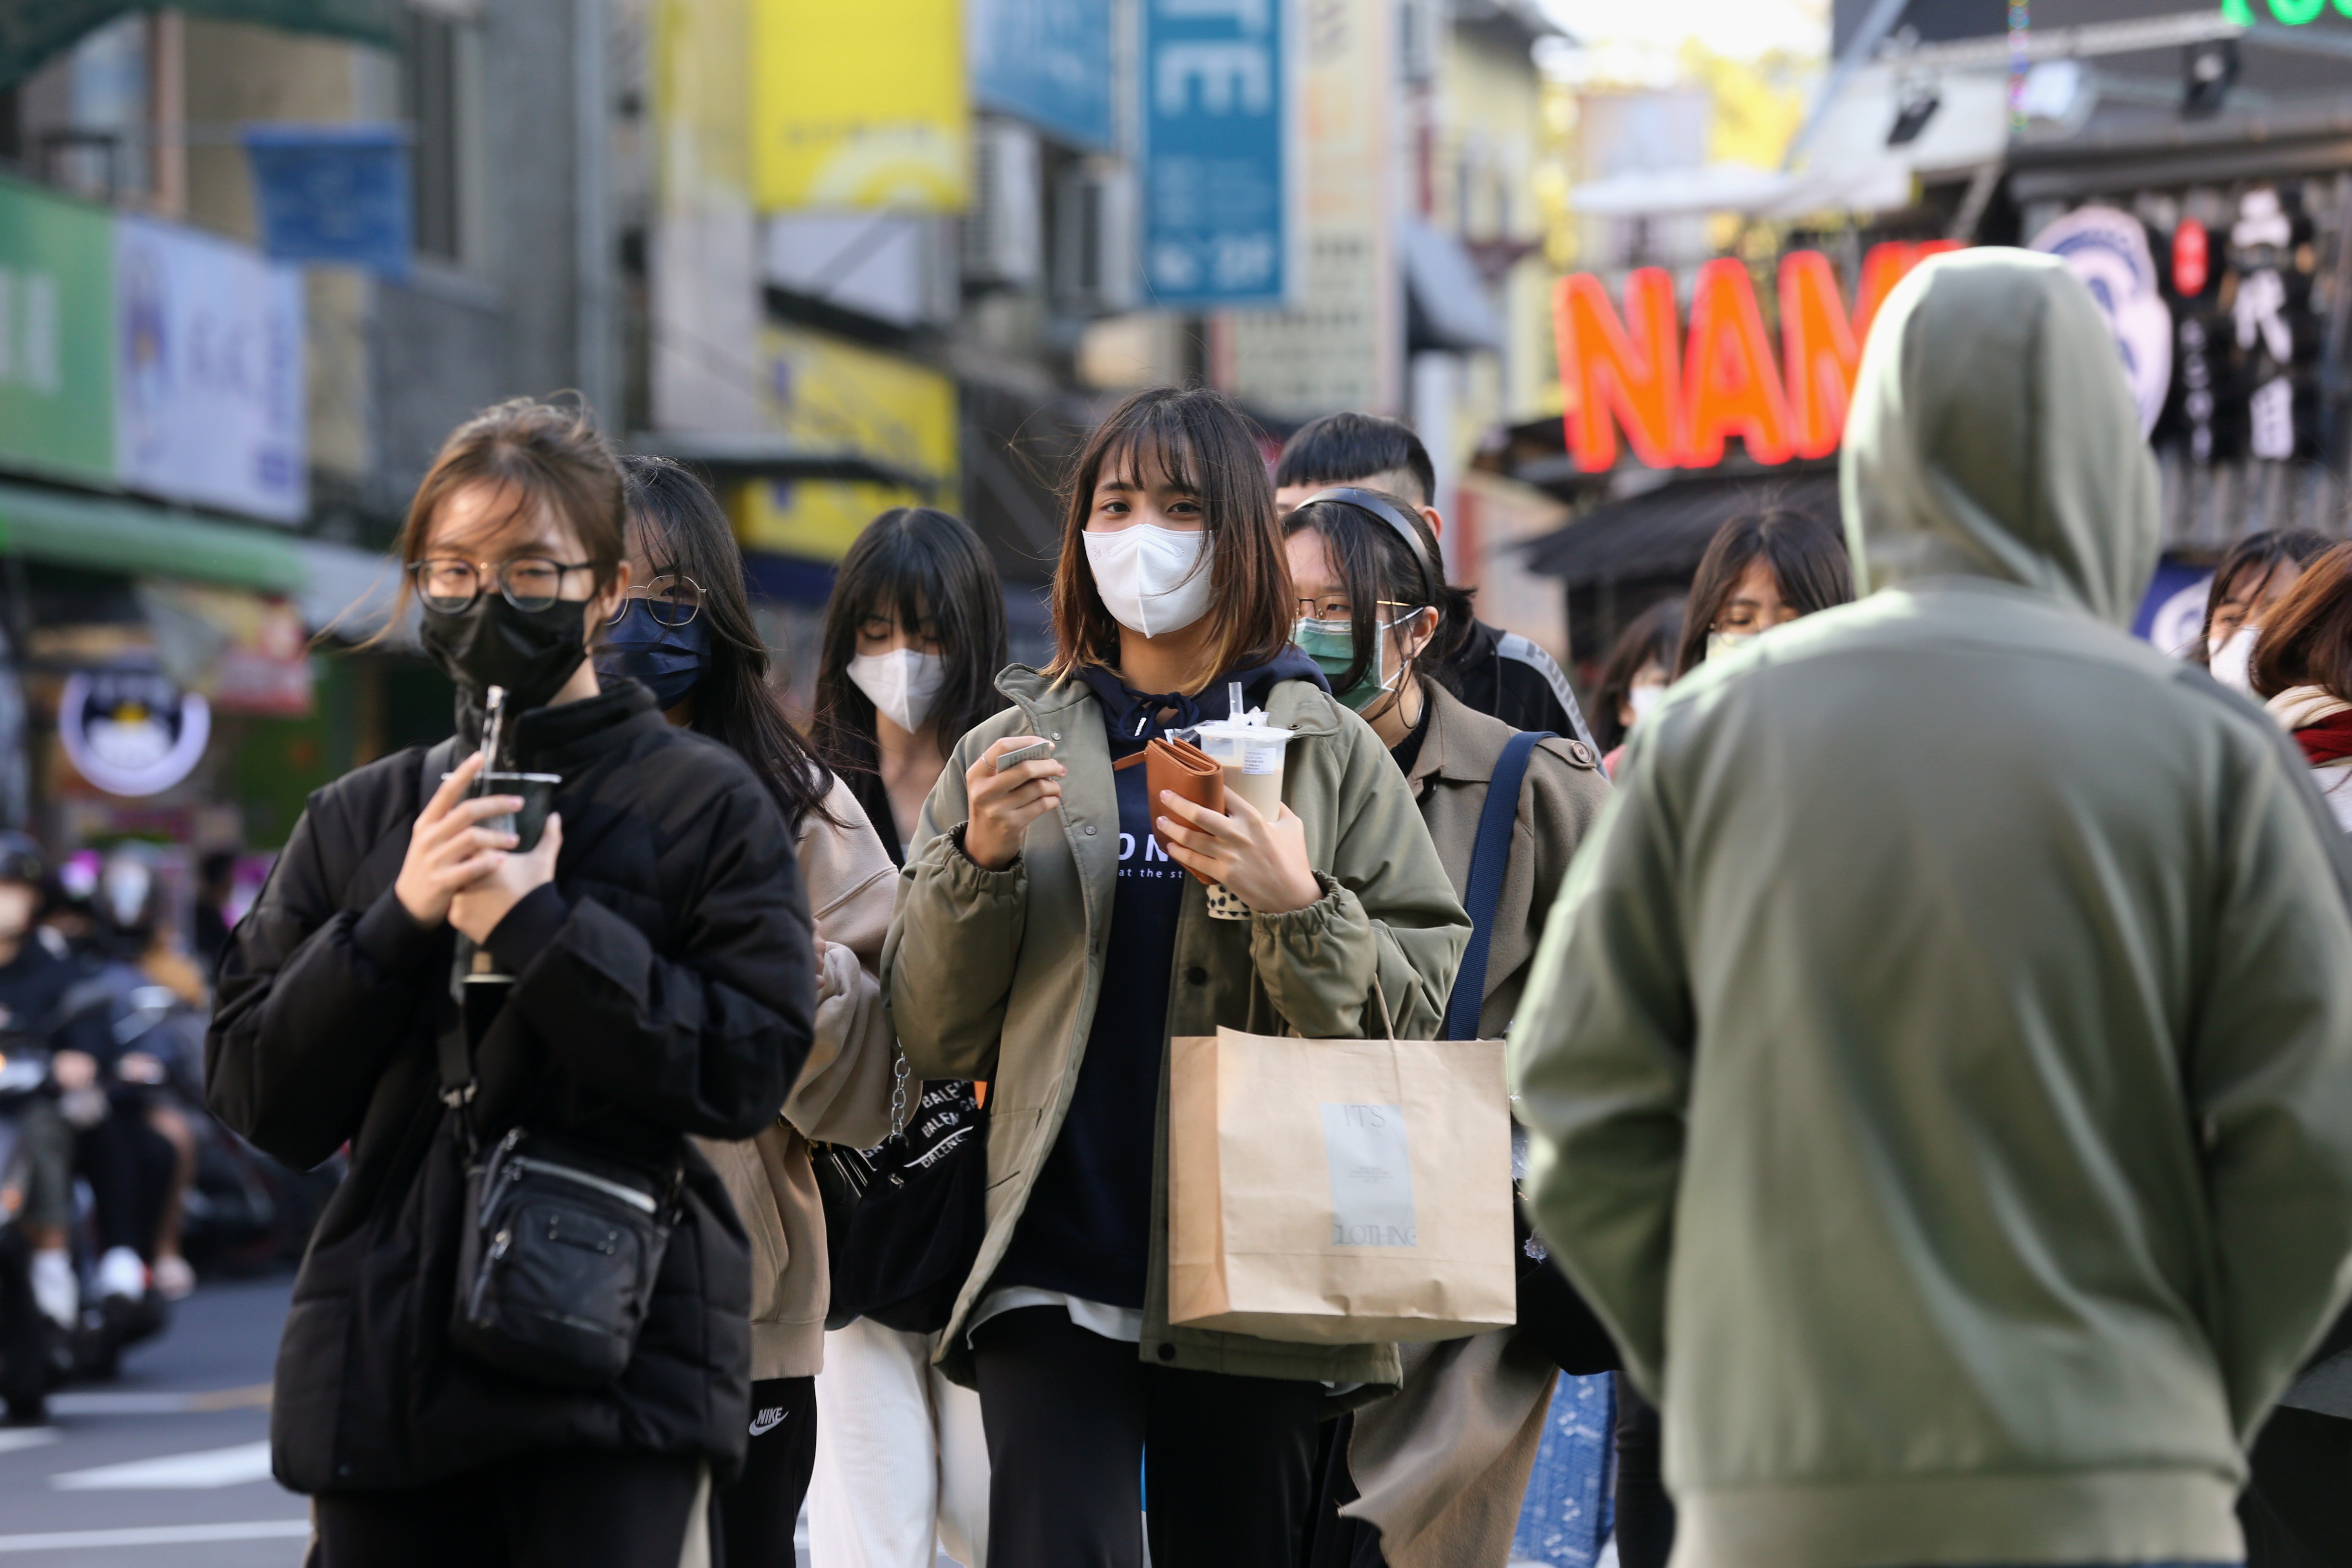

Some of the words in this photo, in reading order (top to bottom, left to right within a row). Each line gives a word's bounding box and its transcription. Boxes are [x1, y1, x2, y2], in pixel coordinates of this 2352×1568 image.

[1553, 240, 1966, 473] NAM
[1140, 868, 1163, 878] the
[1343, 1104, 1385, 1128] ITS
[756, 1406, 783, 1425] NIKE
